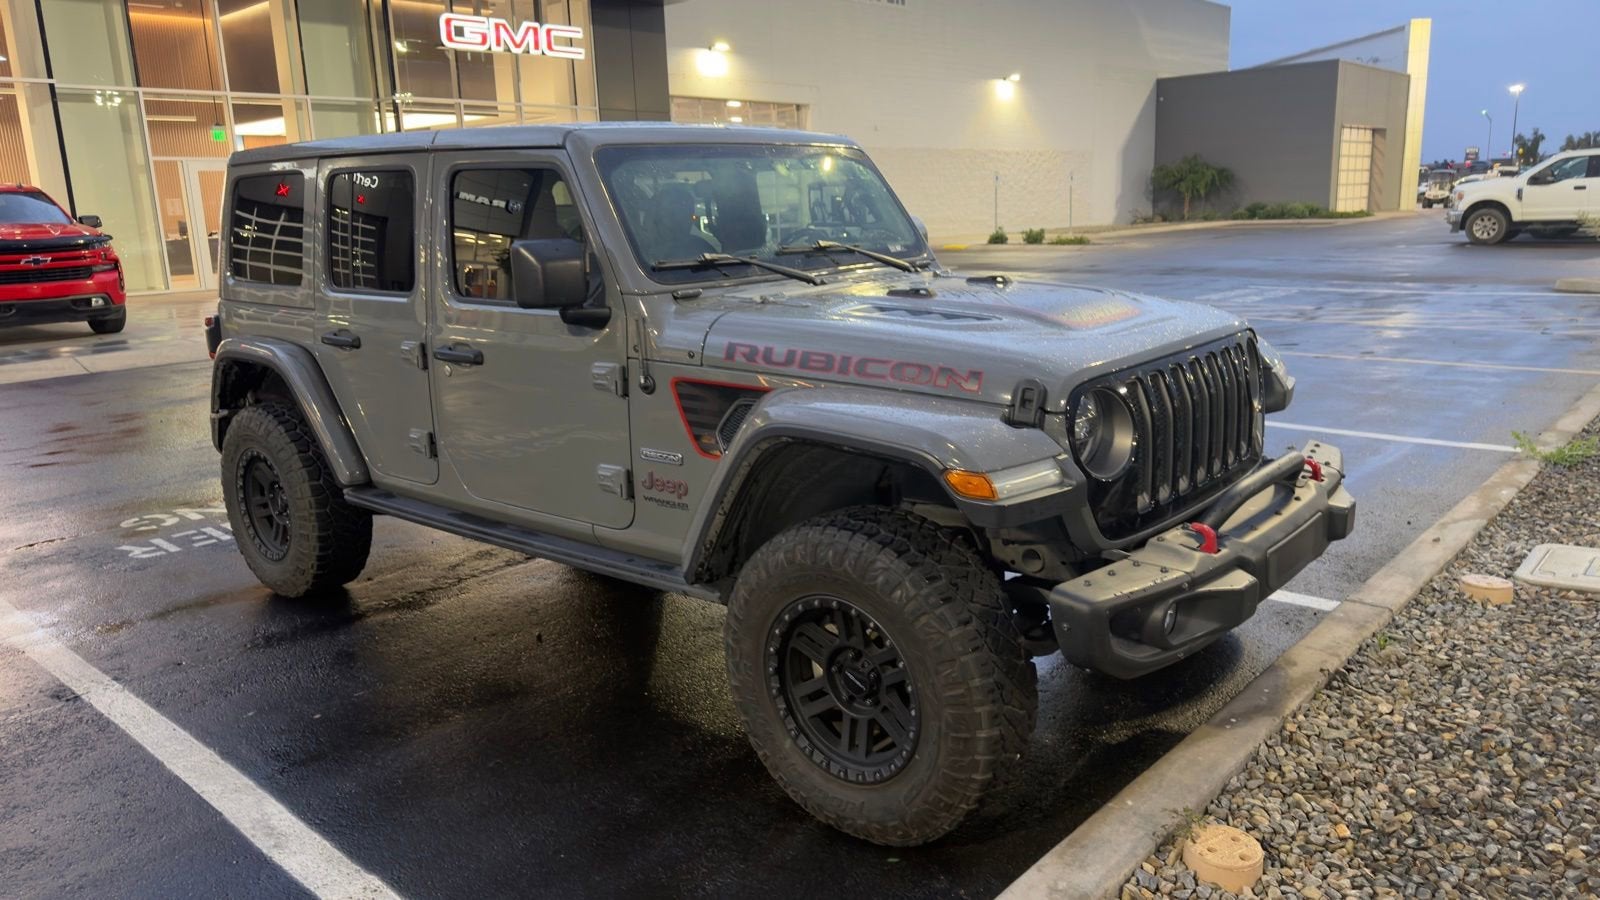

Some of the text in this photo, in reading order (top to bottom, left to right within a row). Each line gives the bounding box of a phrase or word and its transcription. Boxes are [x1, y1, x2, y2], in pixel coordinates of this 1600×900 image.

[440, 13, 585, 59] GMC
[724, 341, 984, 392] RUBICON
[641, 471, 688, 499] Jeep
